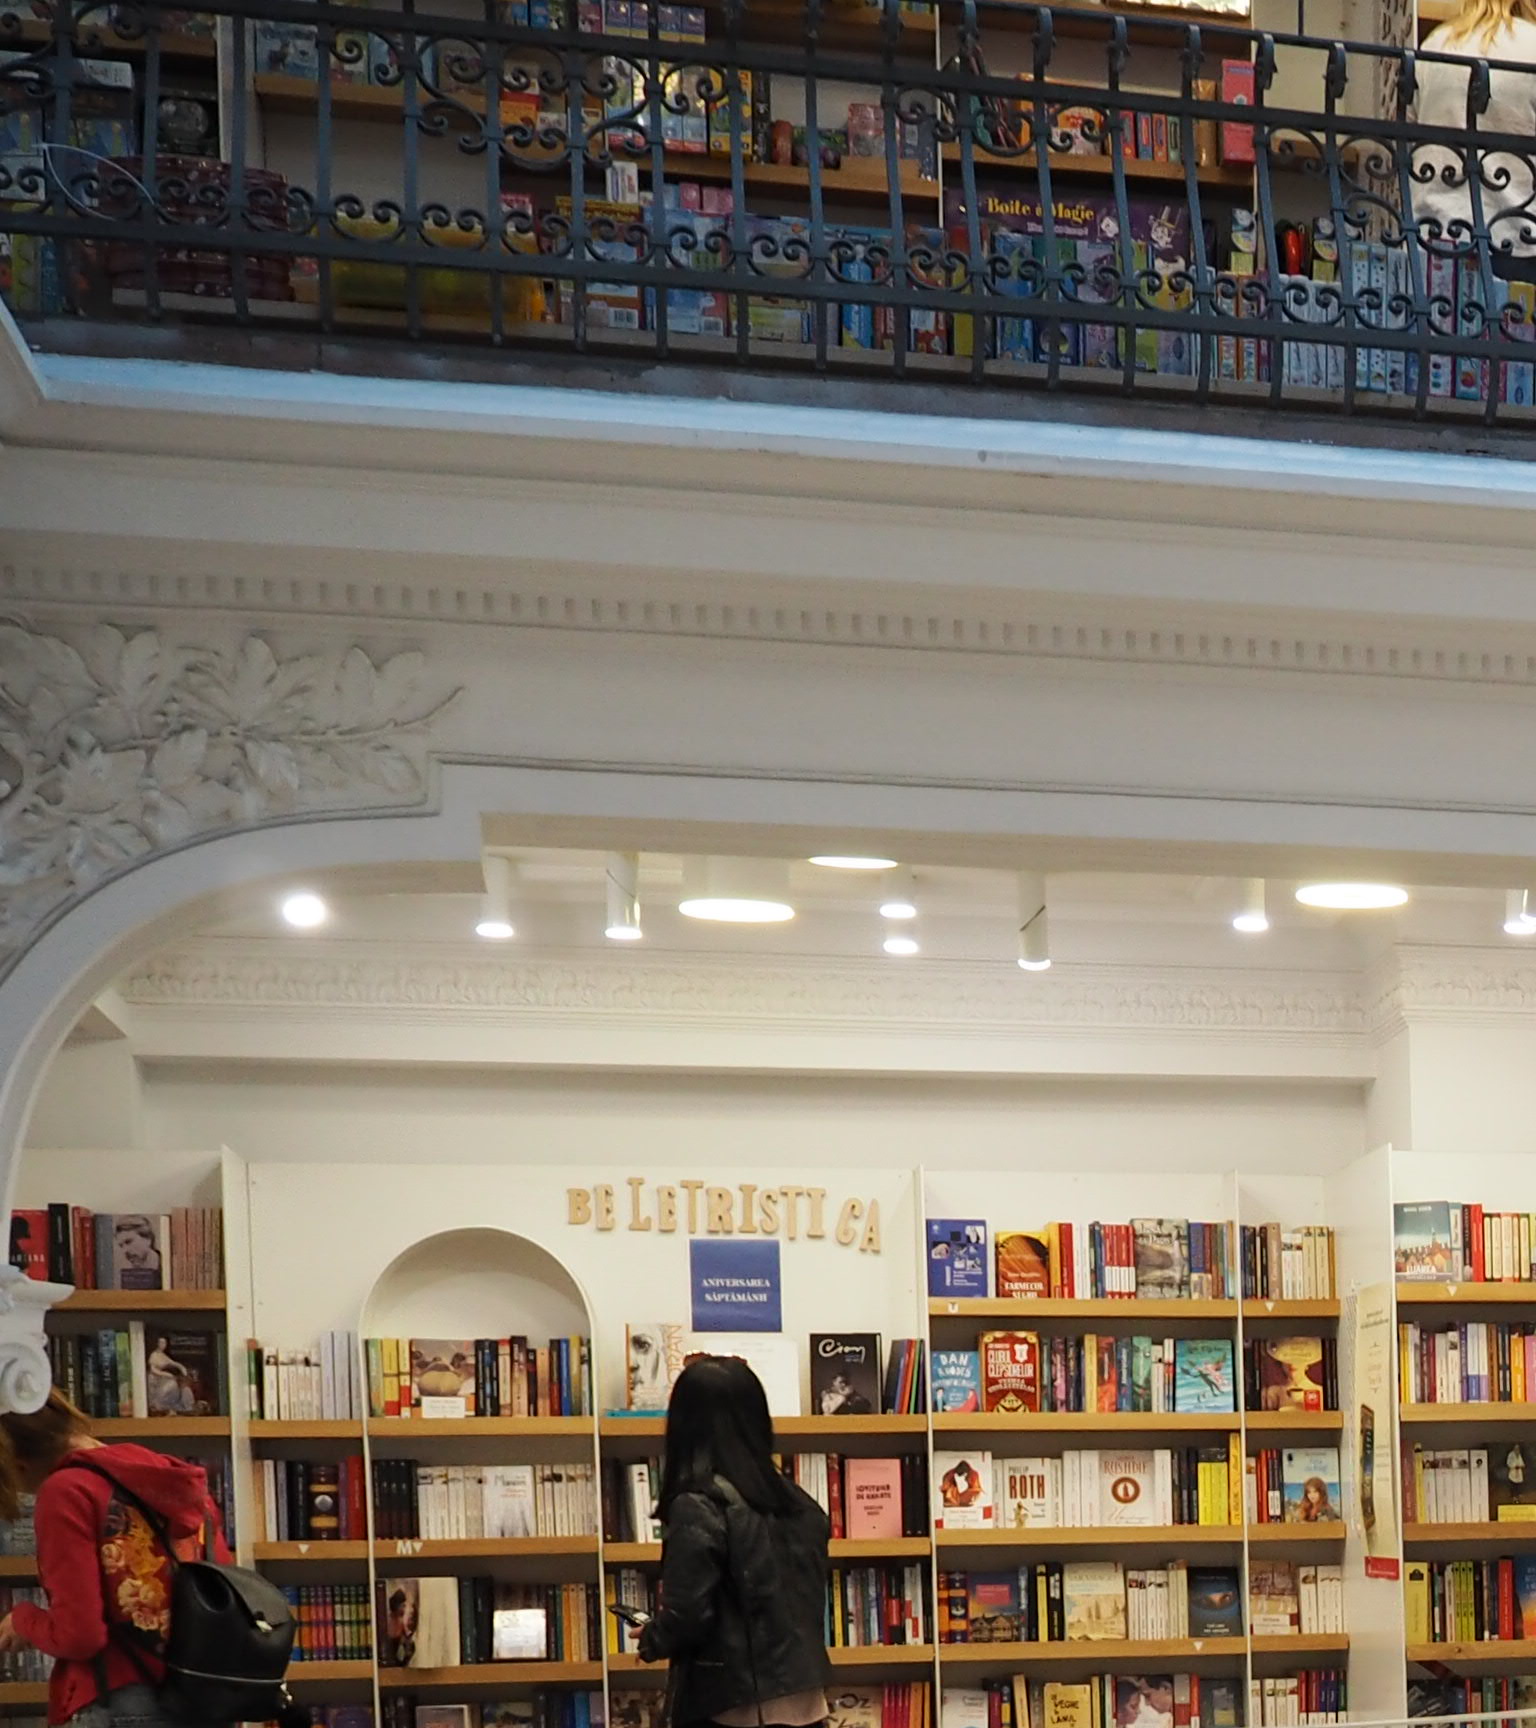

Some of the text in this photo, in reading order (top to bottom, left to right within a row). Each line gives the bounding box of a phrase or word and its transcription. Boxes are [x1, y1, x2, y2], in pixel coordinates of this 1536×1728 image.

[702, 1278, 771, 1288] ANIVERSAREA
[939, 1353, 969, 1367] DAN
[1009, 1475, 1045, 1500] ROTH
